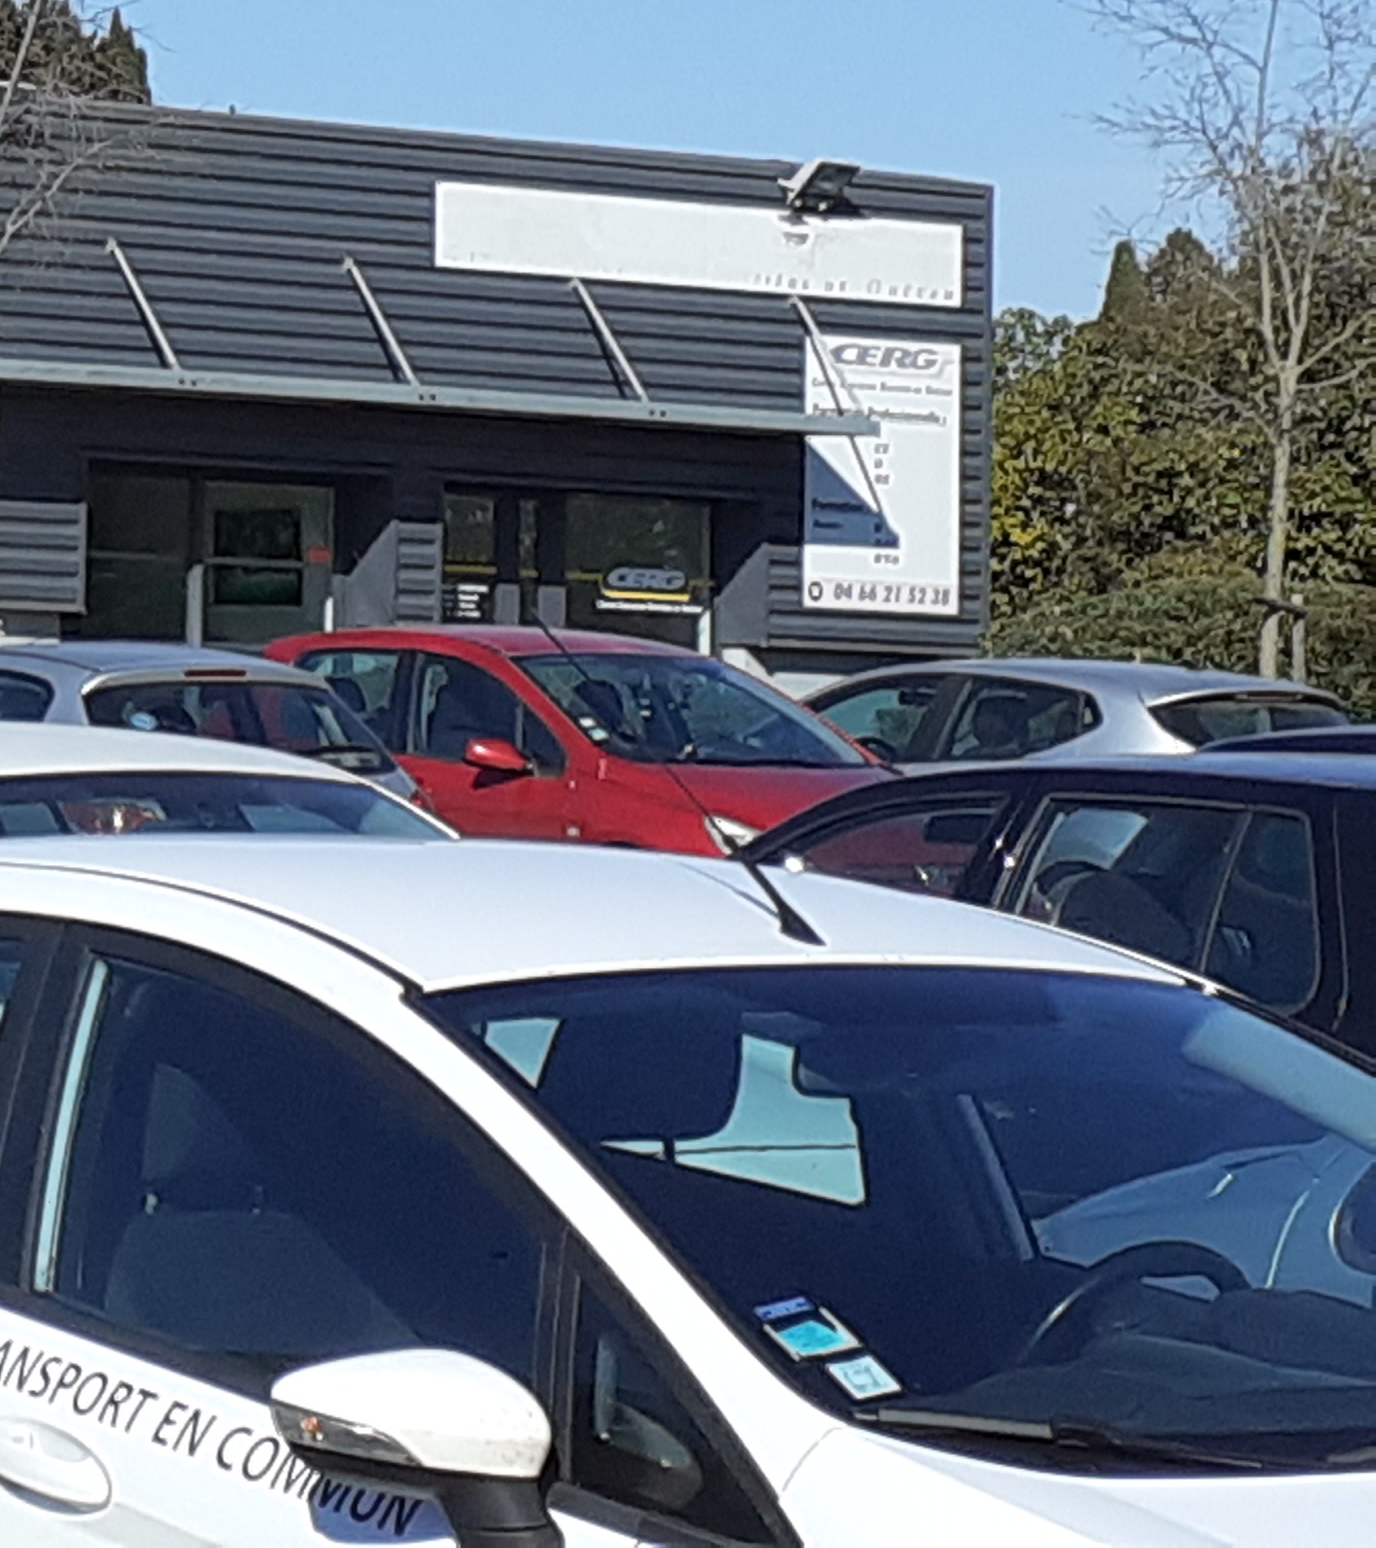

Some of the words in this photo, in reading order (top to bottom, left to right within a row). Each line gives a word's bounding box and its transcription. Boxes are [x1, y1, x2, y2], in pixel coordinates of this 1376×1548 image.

[830, 343, 940, 370] CERG
[833, 583, 853, 601] 04
[151, 1400, 218, 1458] EN
[216, 1426, 426, 1536] COMMUN
